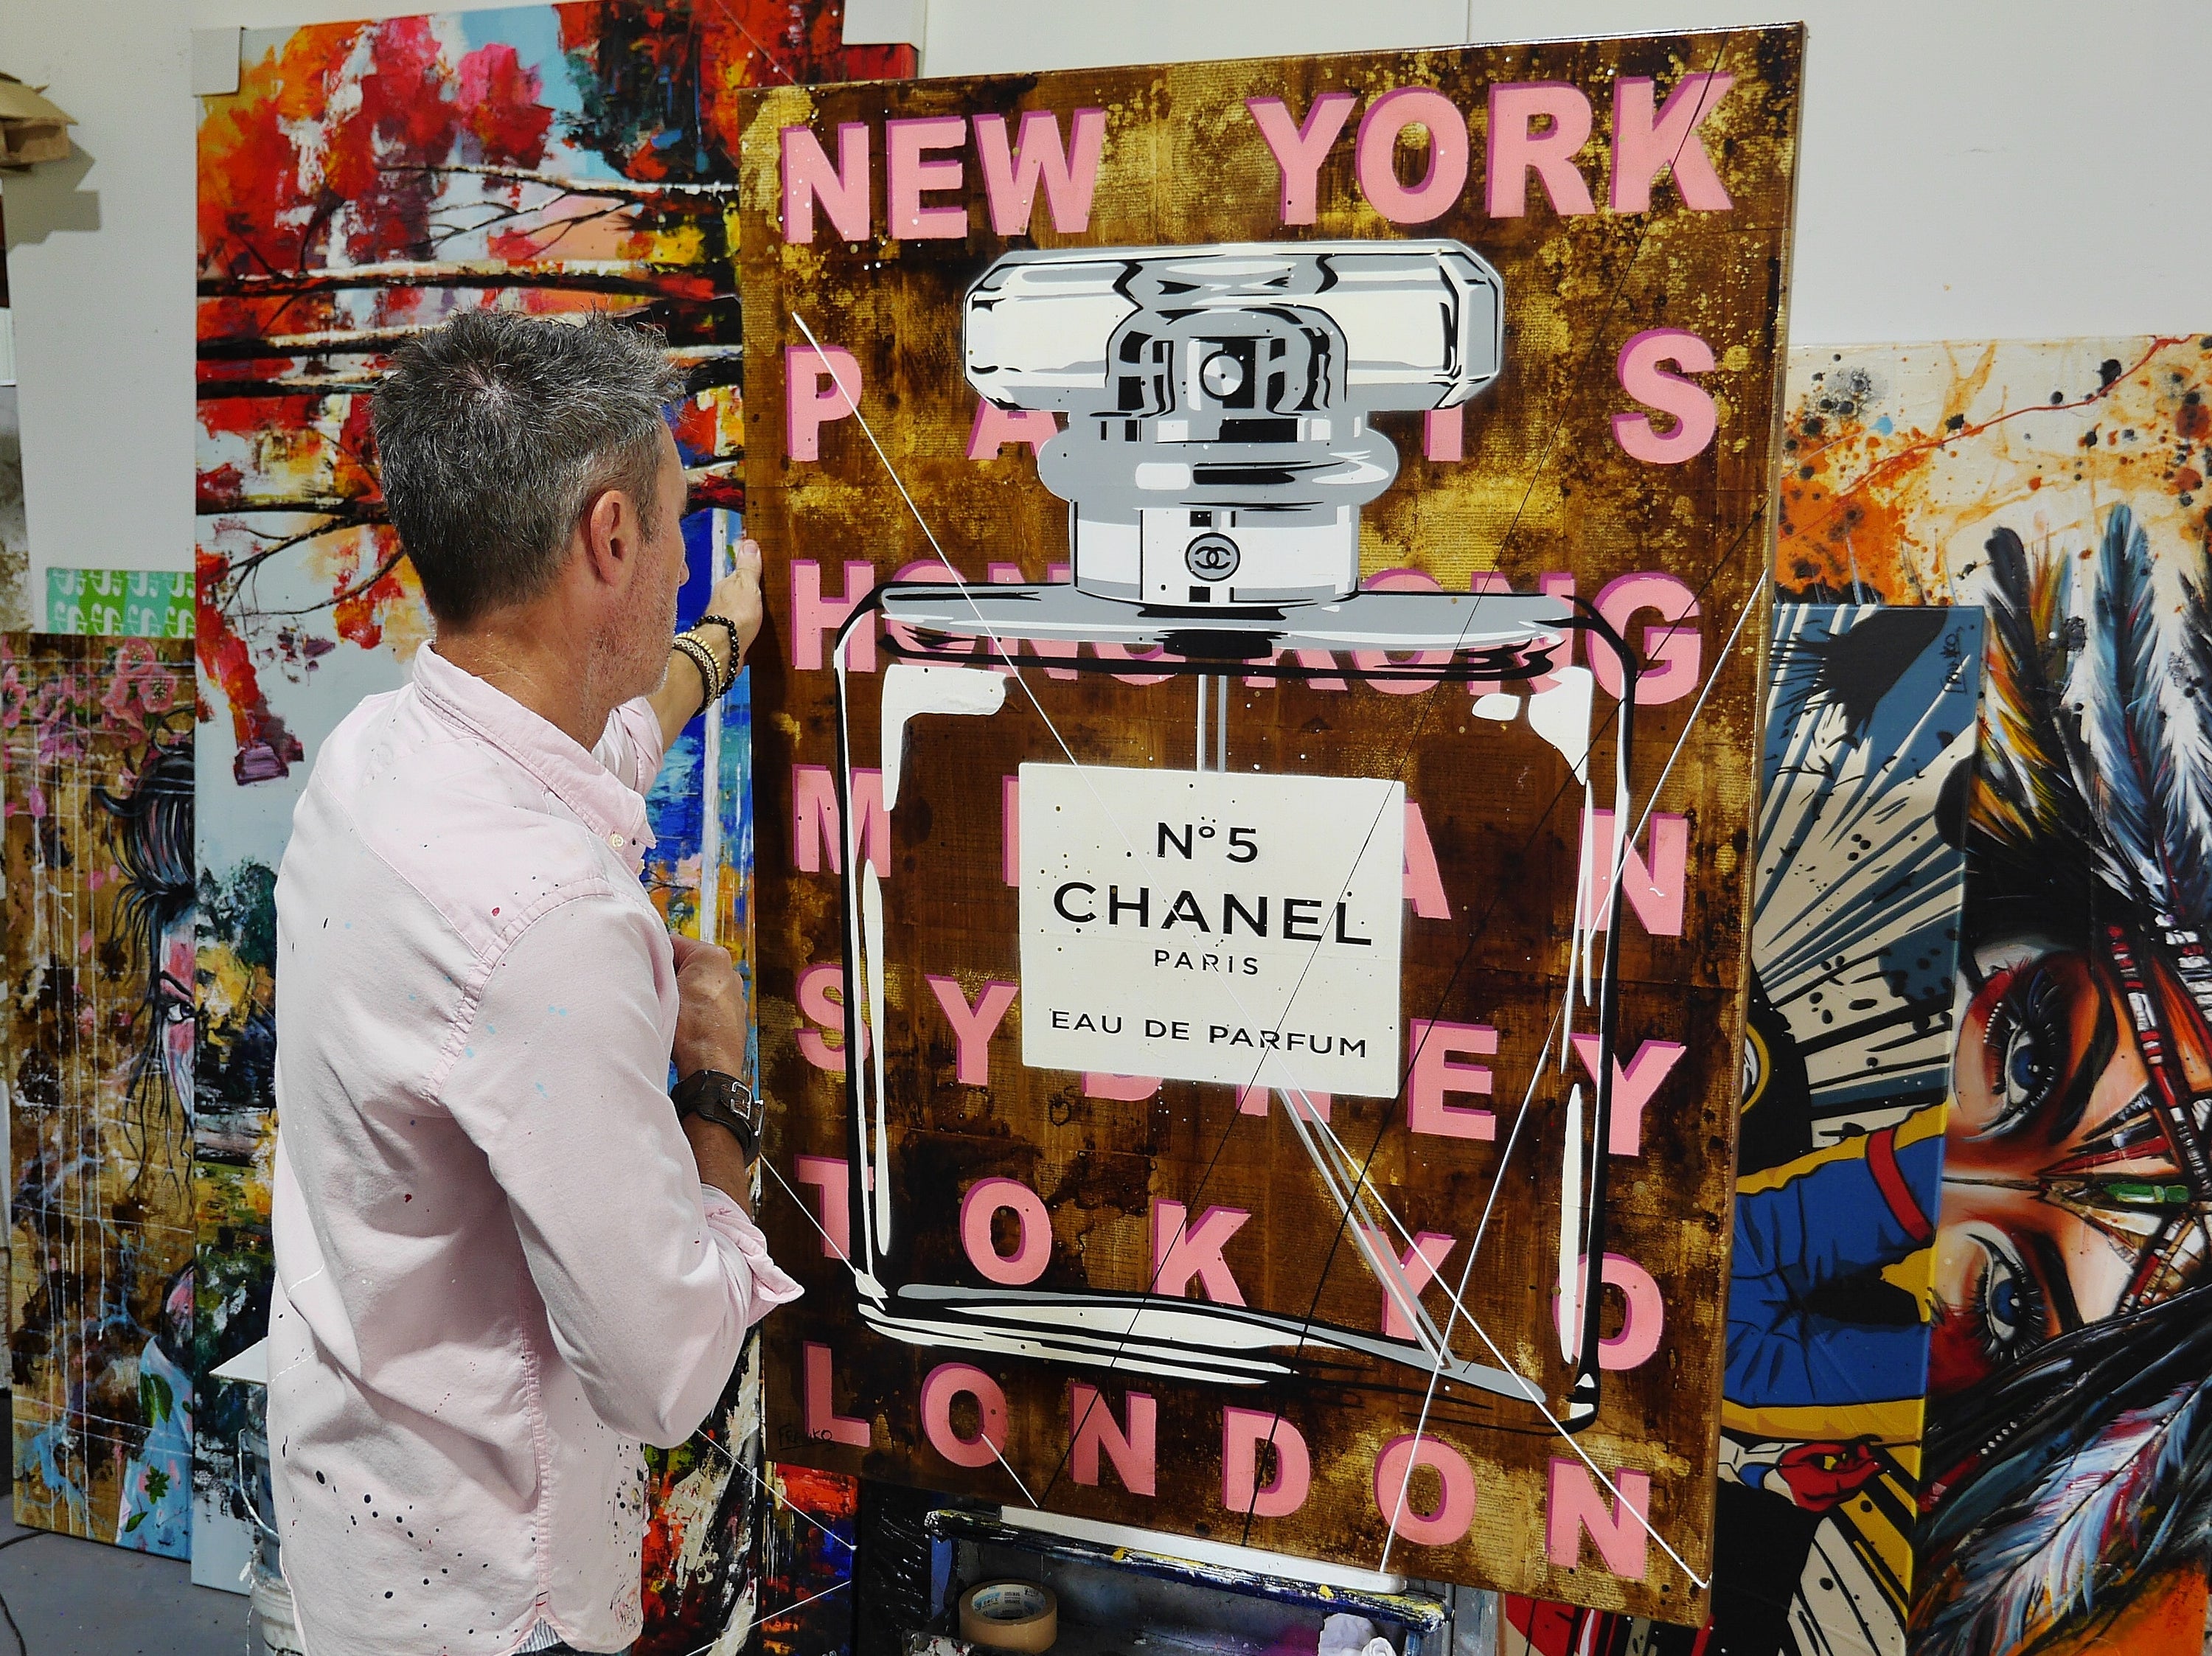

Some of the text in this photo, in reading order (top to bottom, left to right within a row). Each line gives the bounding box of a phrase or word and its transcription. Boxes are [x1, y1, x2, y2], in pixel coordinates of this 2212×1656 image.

[782, 72, 1735, 243] NEW YORK
[1054, 883, 1371, 945] CHANEL
[1155, 949, 1259, 975] PARIS
[1051, 1011, 1366, 1058] EAU DE PARFUM
[794, 1154, 1664, 1371] TOKYO
[803, 1340, 1650, 1580] LONDON
